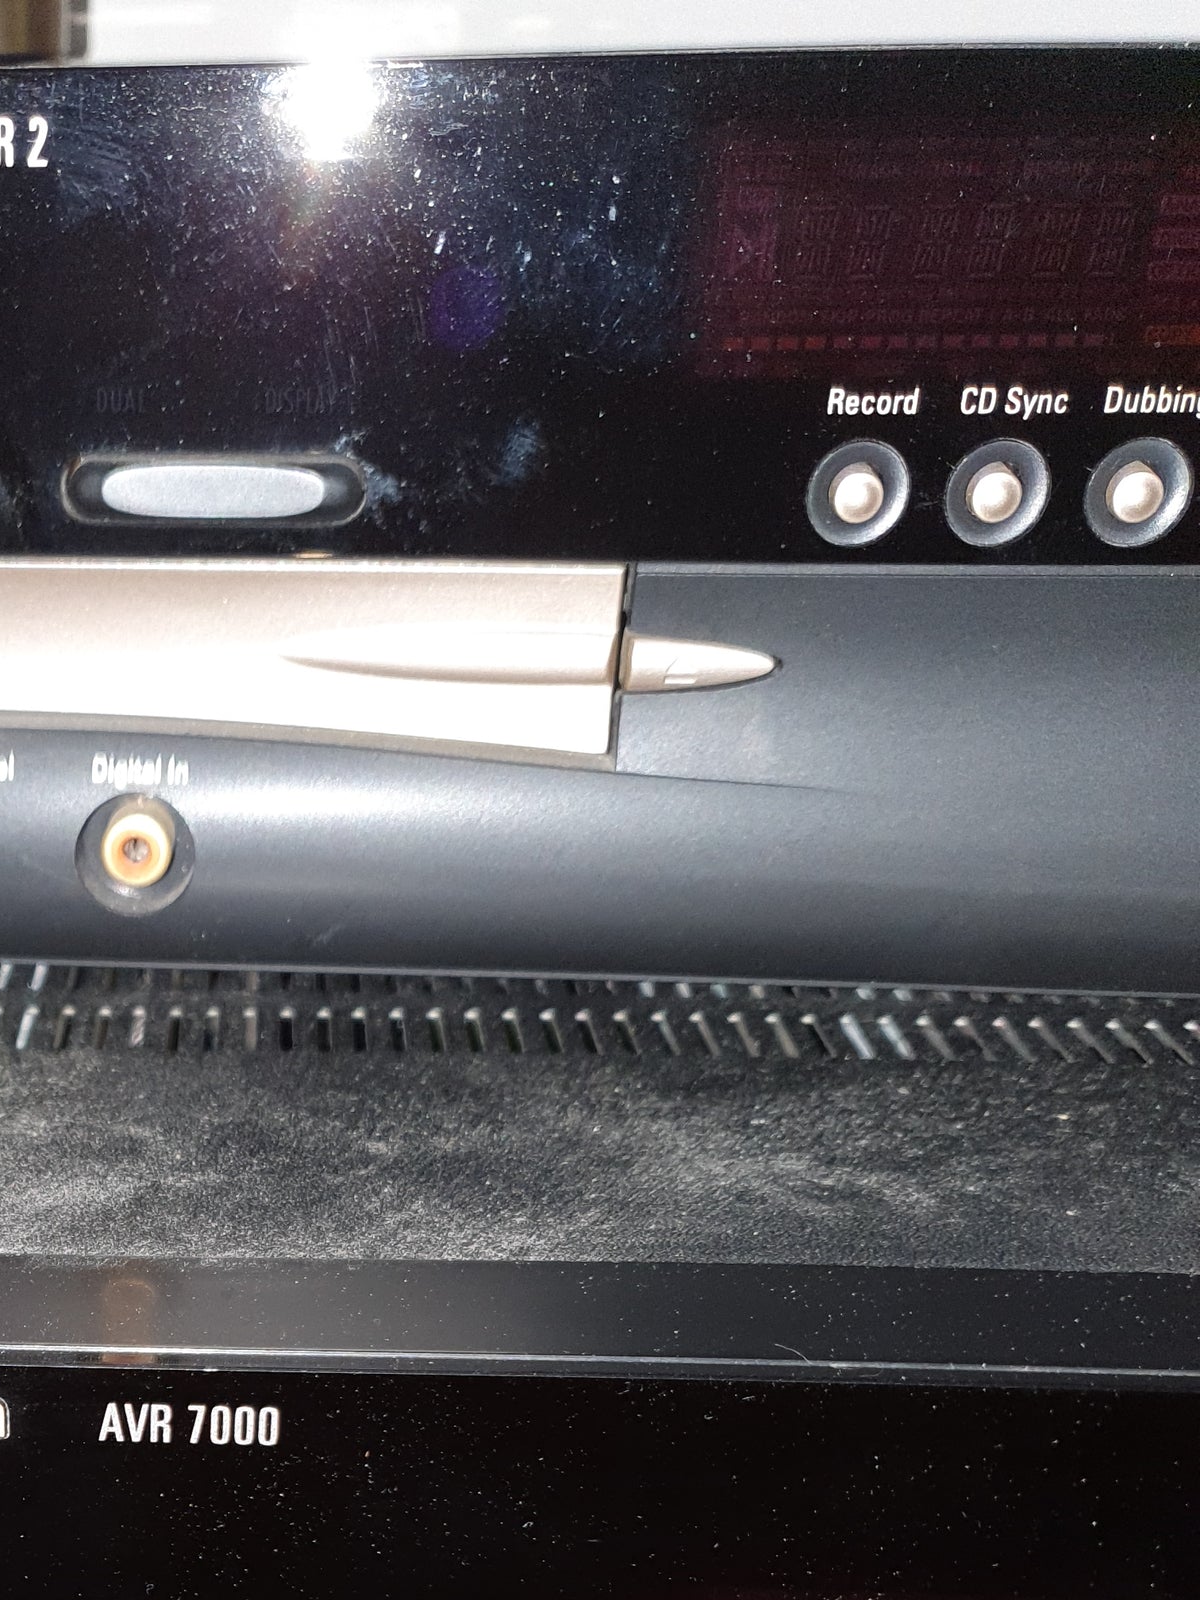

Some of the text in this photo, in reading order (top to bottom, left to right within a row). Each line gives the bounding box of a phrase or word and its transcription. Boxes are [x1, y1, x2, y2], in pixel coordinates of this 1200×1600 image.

[27, 116, 48, 168] 2
[827, 384, 920, 416] Record
[960, 385, 1069, 420] CD Sync
[91, 753, 189, 790] Digital In
[98, 1402, 280, 1447] AVR 7000
